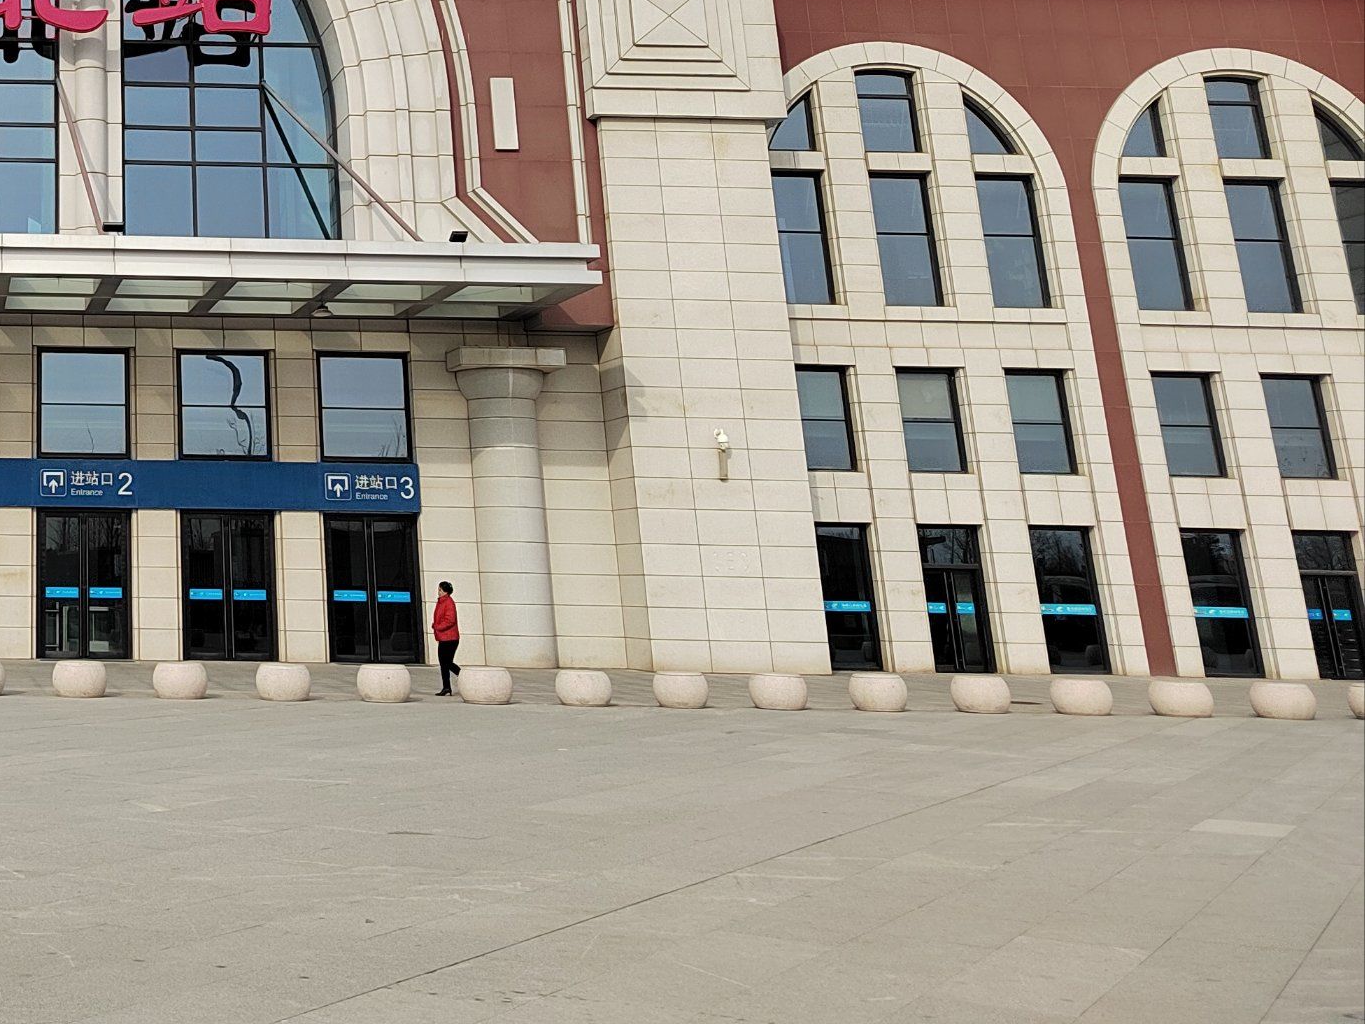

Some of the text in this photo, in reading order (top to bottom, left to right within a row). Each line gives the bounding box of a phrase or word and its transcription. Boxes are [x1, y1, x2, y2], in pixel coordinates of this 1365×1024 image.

[70, 470, 133, 496] 进站口 2
[70, 488, 103, 496] Entrance
[355, 474, 414, 500] 进站口 3
